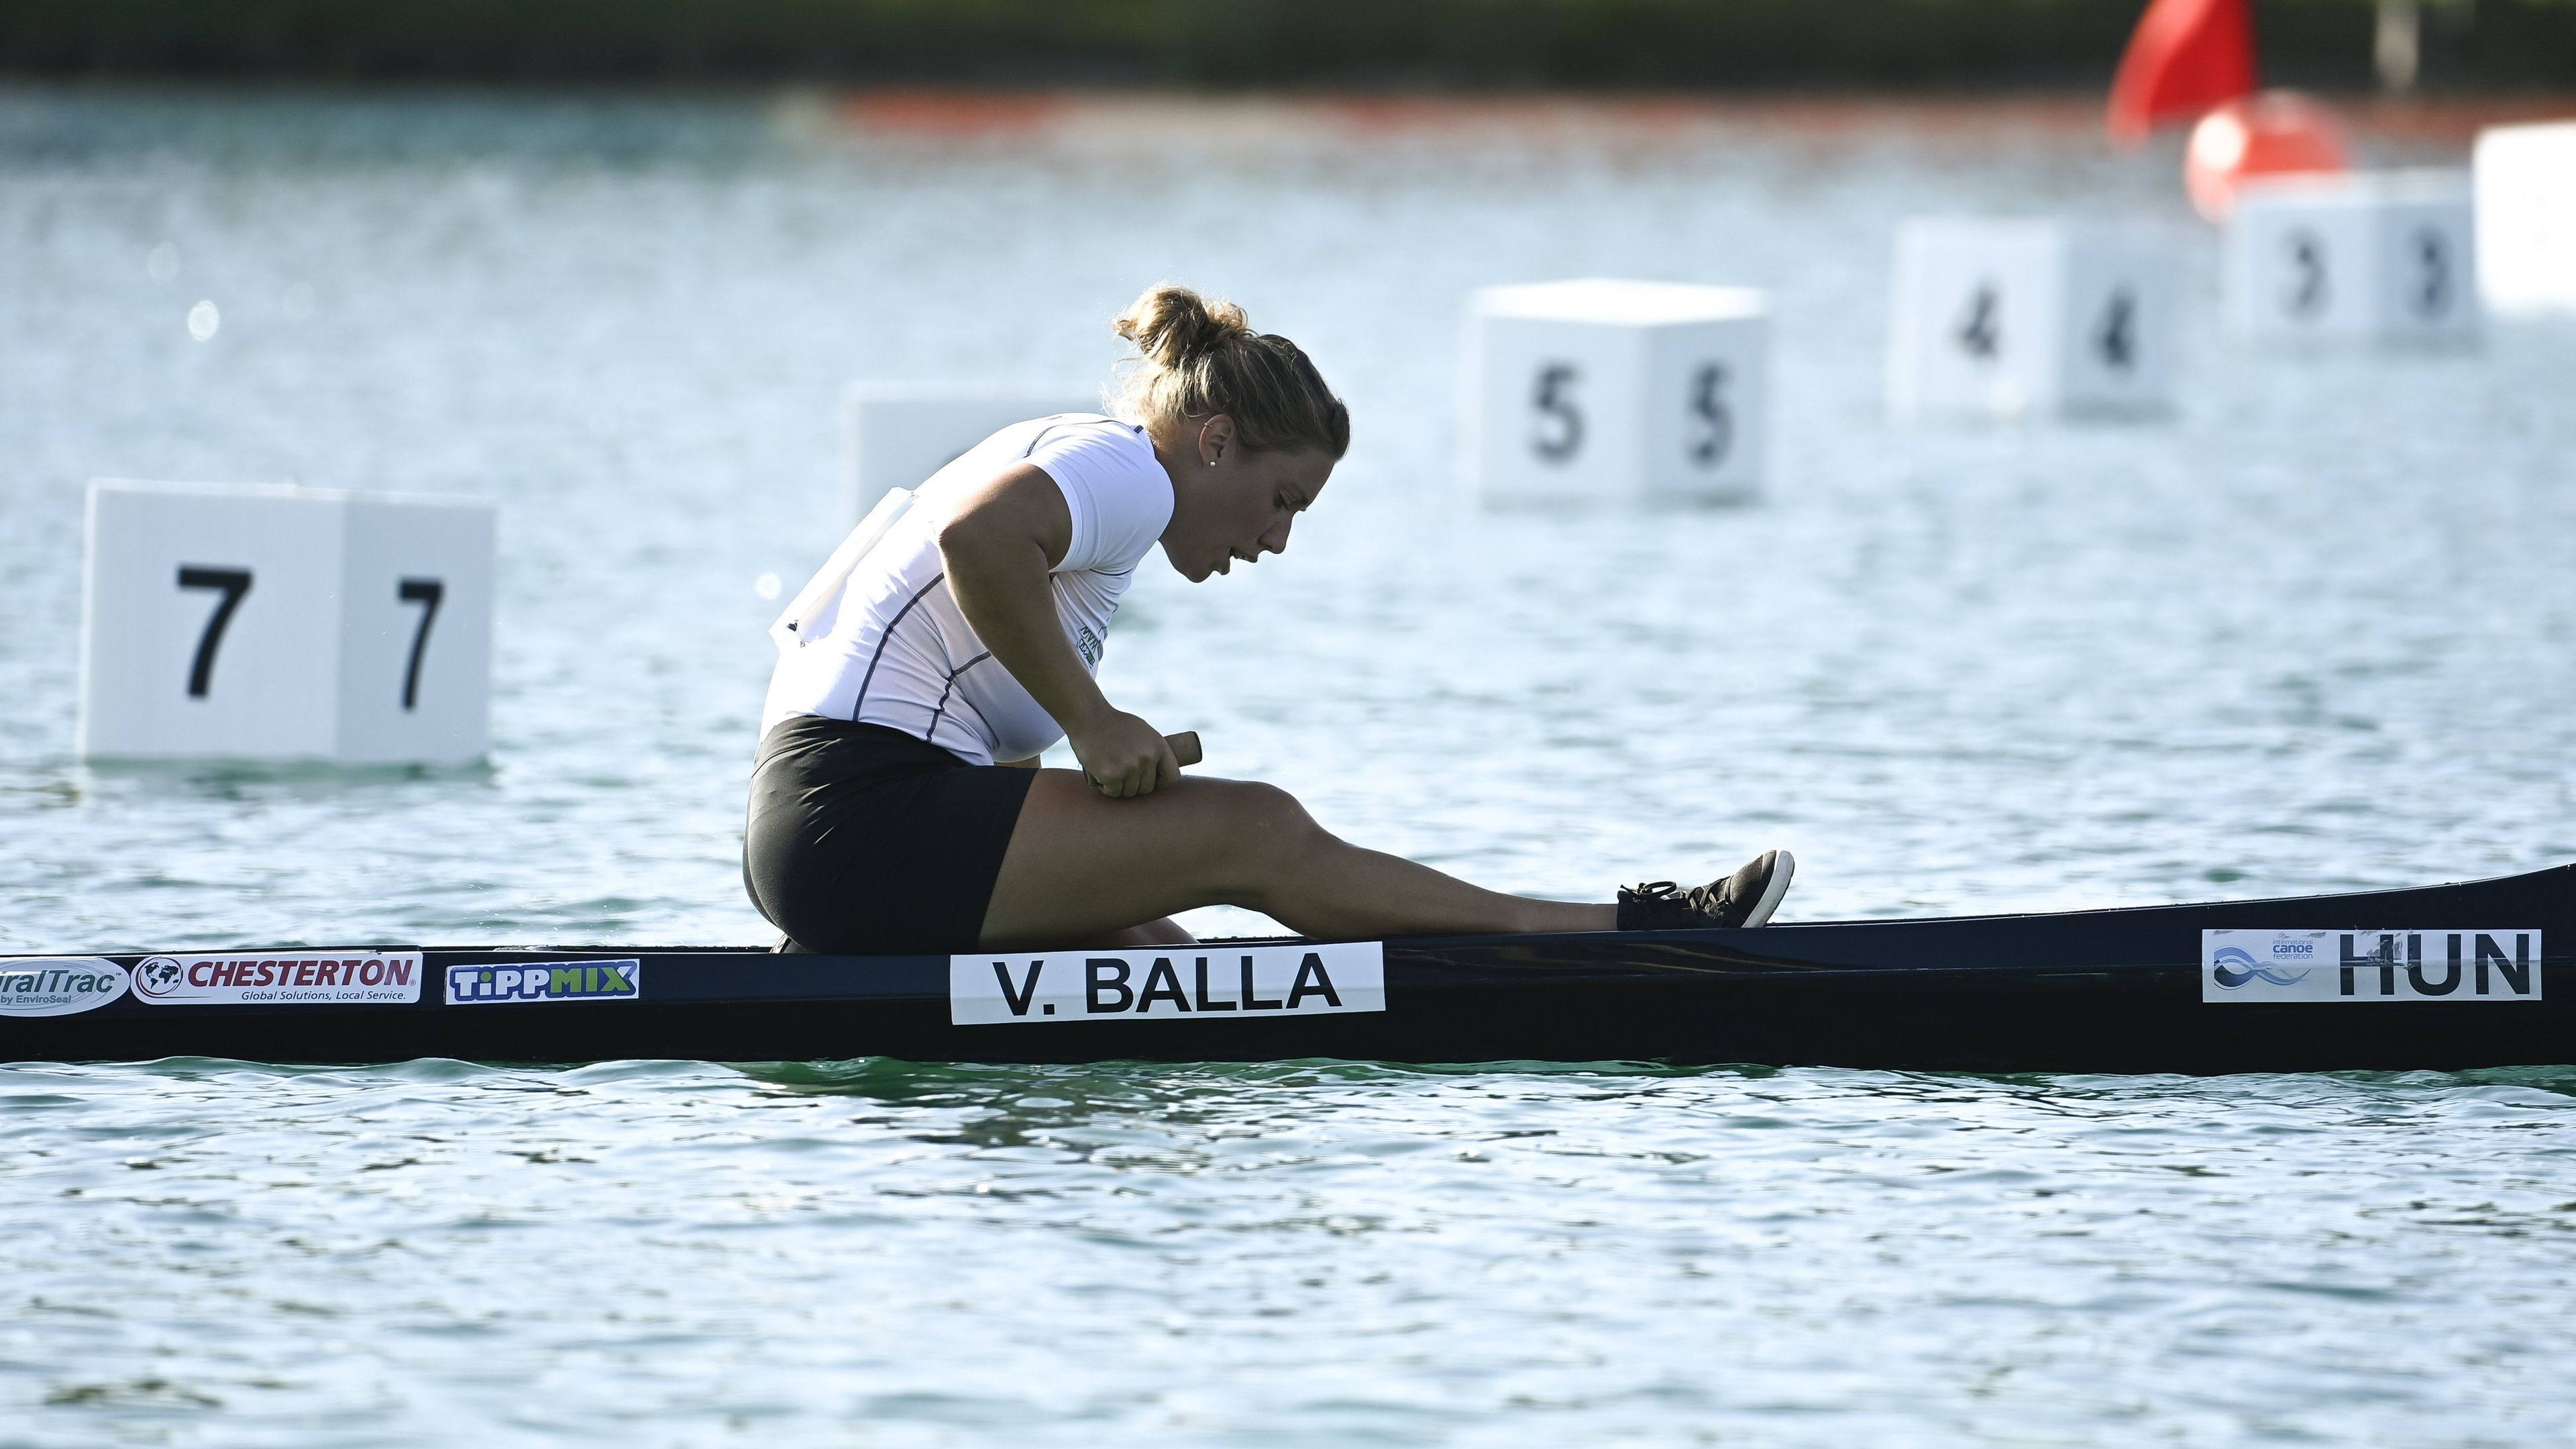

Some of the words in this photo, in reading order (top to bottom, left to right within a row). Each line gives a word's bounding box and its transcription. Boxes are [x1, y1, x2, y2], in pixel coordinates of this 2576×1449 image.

[1530, 360, 1586, 466] 5
[1686, 360, 1733, 468] 5
[177, 566, 254, 698] 7
[397, 579, 444, 712] 7
[2273, 945, 2313, 953] canoe
[2340, 934, 2530, 996] HUN
[189, 959, 414, 987] CHESTERTON
[241, 991, 277, 1000] Global
[280, 991, 332, 1001] Solutions,
[336, 991, 364, 1000] Local
[367, 990, 406, 1000] Service.
[992, 960, 1055, 1016] V.
[1085, 953, 1342, 1014] BALLA
[1, 996, 13, 1005] by
[16, 995, 71, 1004] EnviroSeal
